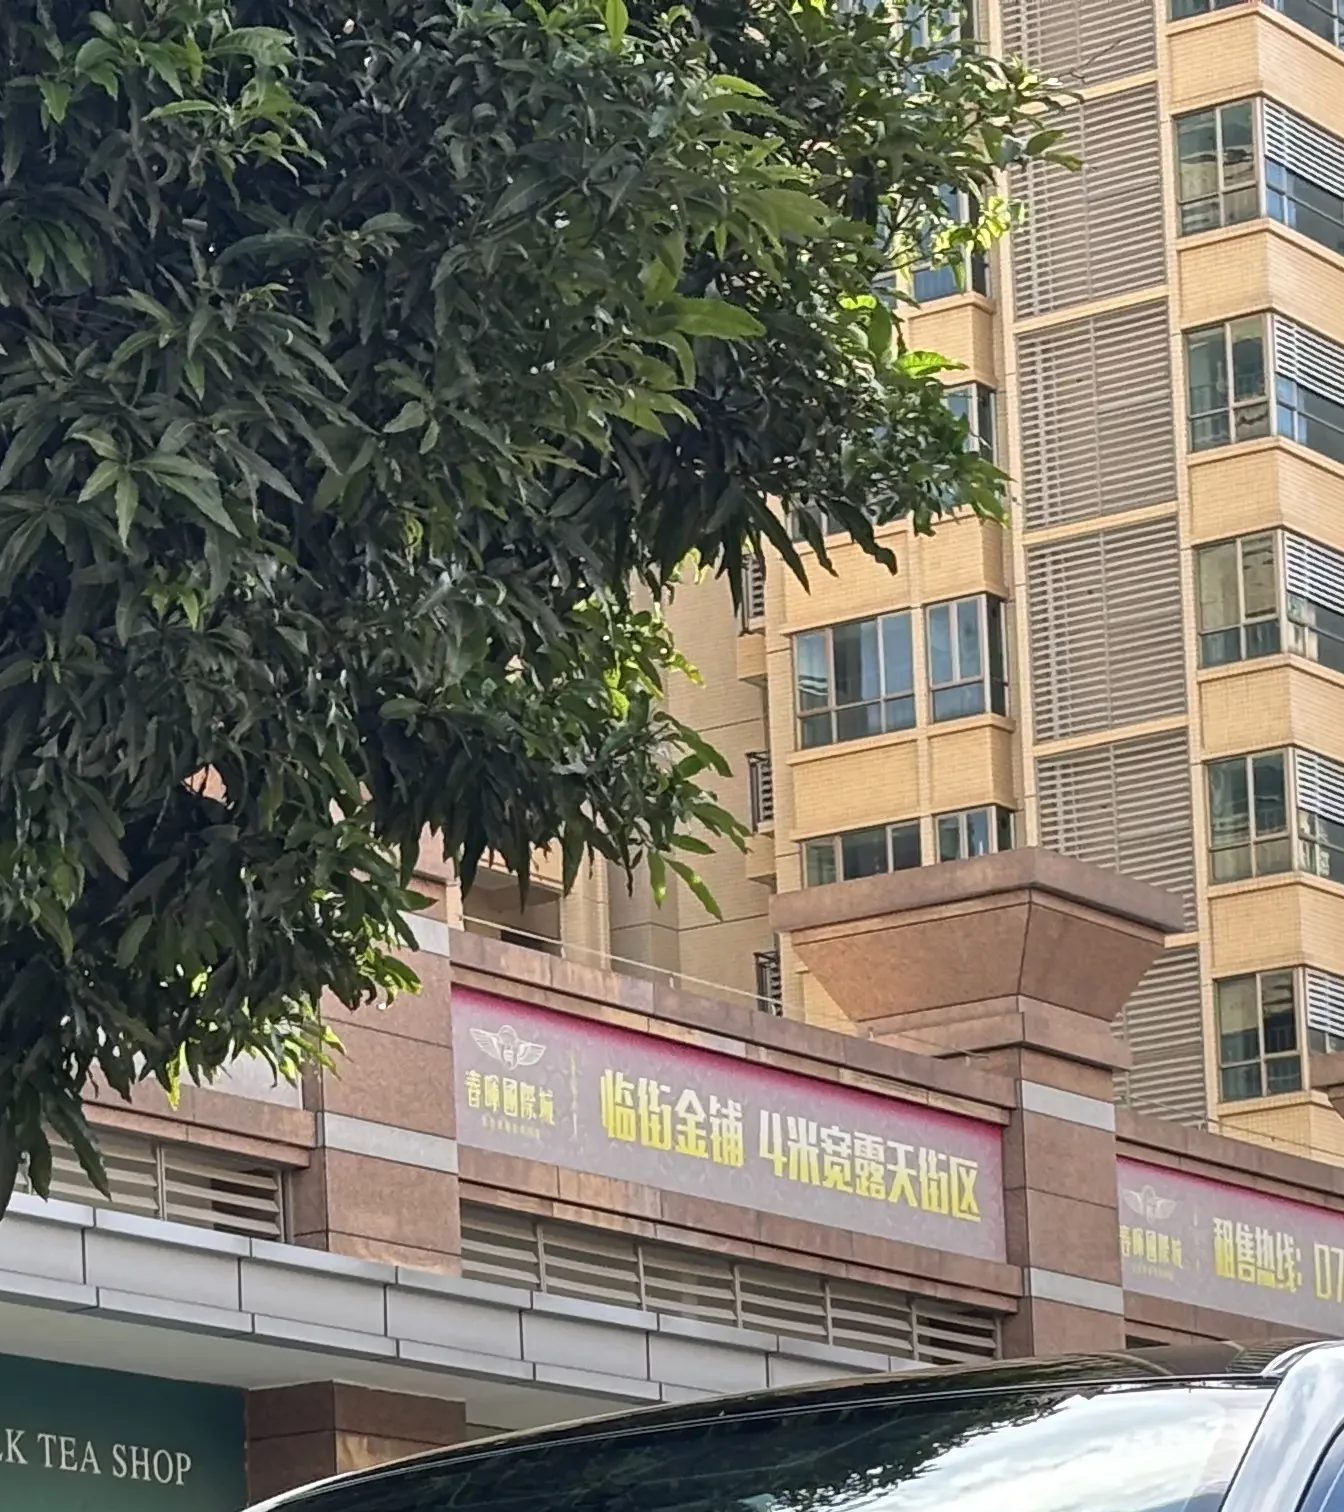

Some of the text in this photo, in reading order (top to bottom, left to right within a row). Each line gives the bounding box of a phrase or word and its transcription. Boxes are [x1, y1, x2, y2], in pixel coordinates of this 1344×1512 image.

[599, 1068, 981, 1223] 临街金铺 4米宽露天街区
[37, 1432, 101, 1475] TEA
[112, 1443, 192, 1486] SHOP
